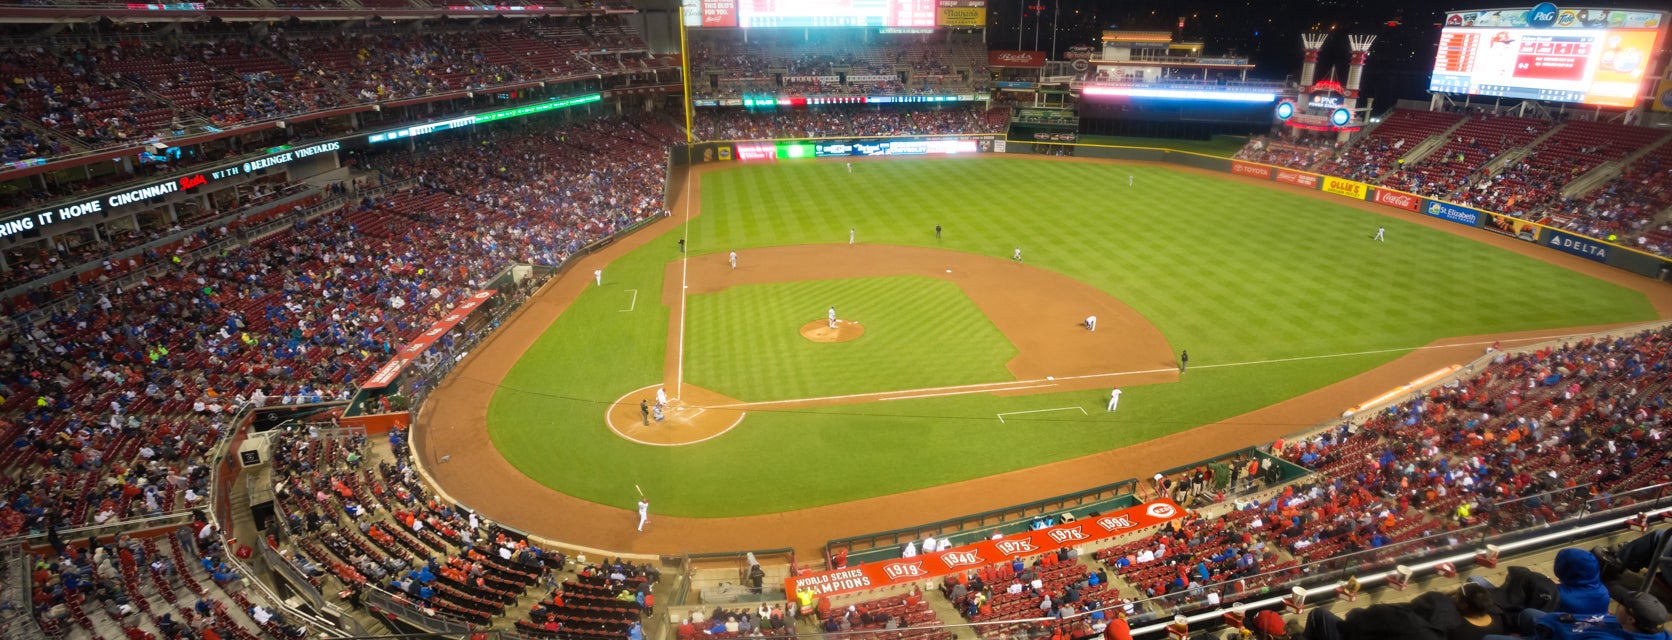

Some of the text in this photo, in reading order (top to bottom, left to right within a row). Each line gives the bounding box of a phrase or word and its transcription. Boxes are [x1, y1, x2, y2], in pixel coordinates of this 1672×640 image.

[1533, 11, 1555, 21] P&G
[1558, 13, 1575, 24] Tide
[998, 52, 1033, 61] Reds
[1321, 96, 1338, 106] PNC
[1244, 166, 1268, 176] TOYOTA
[38, 211, 53, 226] IT
[59, 200, 102, 220] HOME
[108, 181, 178, 208] CINCINNATI
[179, 172, 208, 191] Reds
[212, 166, 239, 180] WITH
[251, 152, 294, 171] BERINGER
[295, 141, 340, 159] VINEYARDS
[1329, 180, 1360, 194] OLLIE'S
[1382, 192, 1411, 207] Coca-Cola
[1440, 206, 1476, 221] St. Elizabeth
[1564, 238, 1606, 257] DELTA
[1100, 517, 1129, 530] 1990
[1051, 528, 1082, 541] 1976
[1000, 540, 1031, 554] 1975
[944, 552, 976, 567] 1940
[886, 564, 919, 577] 1919
[796, 568, 863, 588] WORLD SERIES
